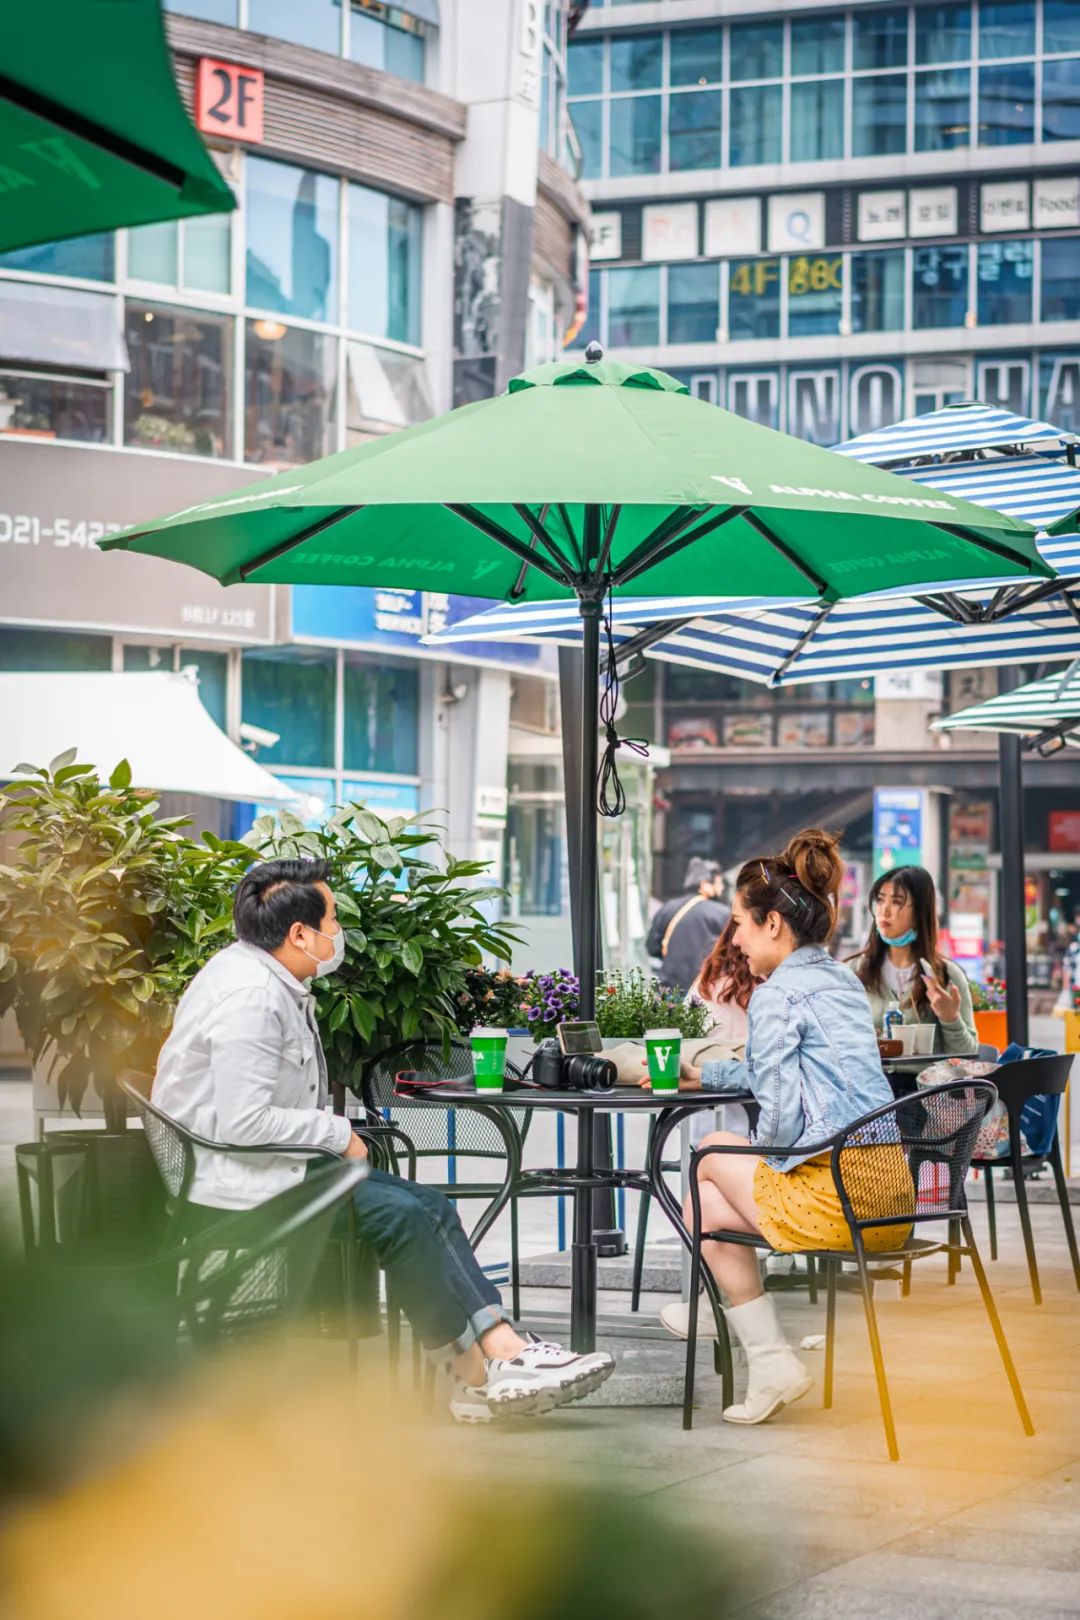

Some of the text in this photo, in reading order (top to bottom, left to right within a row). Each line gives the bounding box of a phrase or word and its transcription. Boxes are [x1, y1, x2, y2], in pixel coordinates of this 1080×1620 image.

[206, 67, 258, 128] 2F
[784, 209, 812, 243] Q
[730, 261, 779, 296] 4F
[769, 484, 861, 501] ALPHA
[0, 513, 135, 550] 021-542
